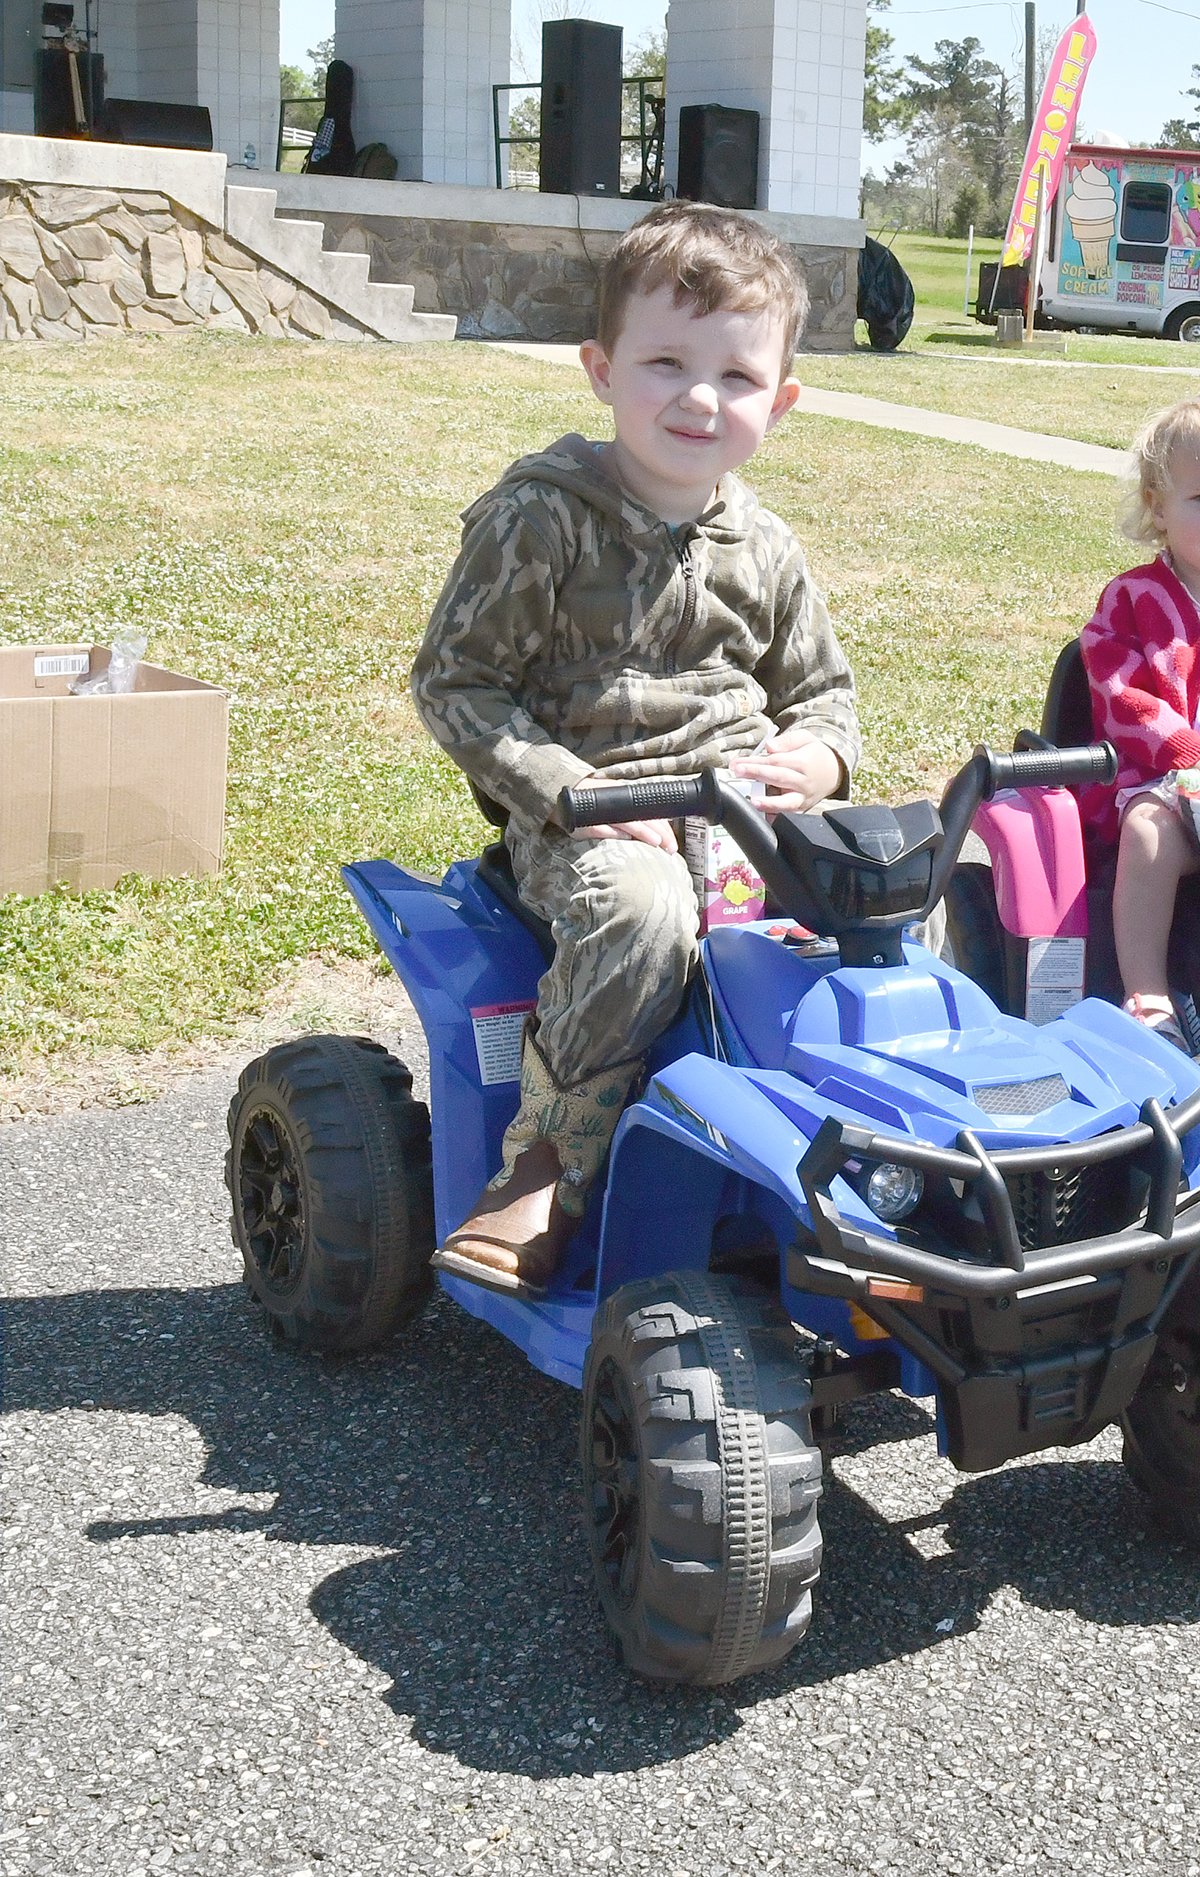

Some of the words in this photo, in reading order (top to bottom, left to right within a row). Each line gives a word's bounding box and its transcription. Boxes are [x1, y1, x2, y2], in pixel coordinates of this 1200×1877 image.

[1094, 265, 1113, 280] ICE
[1064, 280, 1110, 295] CREAM
[1116, 292, 1147, 304] POPCORN
[722, 905, 749, 915] GRAPE
